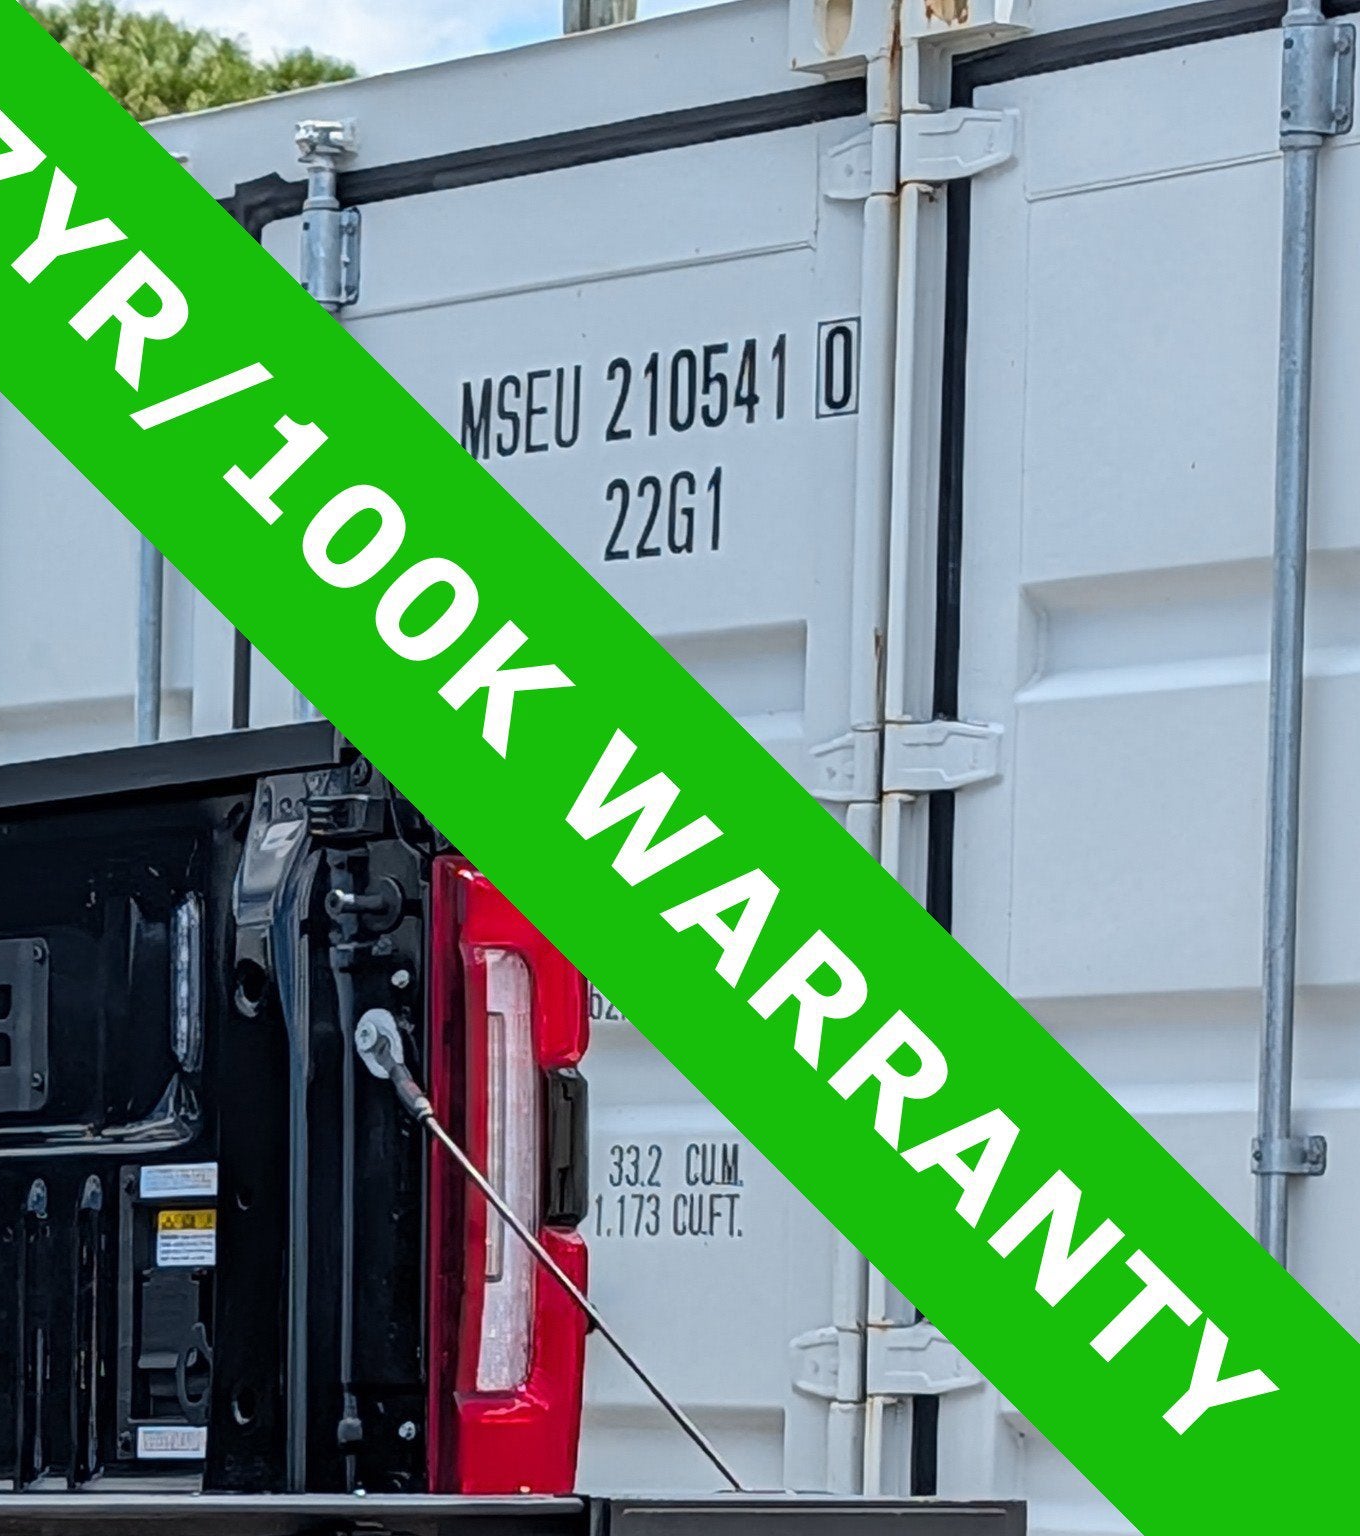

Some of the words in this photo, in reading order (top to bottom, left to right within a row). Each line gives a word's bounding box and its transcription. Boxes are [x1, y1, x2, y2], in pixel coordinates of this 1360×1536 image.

[461, 364, 582, 461] MSEU
[604, 333, 787, 442] 210541
[821, 320, 857, 414] 0
[604, 466, 723, 561] 22G1
[609, 1144, 663, 1187] 33.2
[595, 1193, 661, 1238] 1.173
